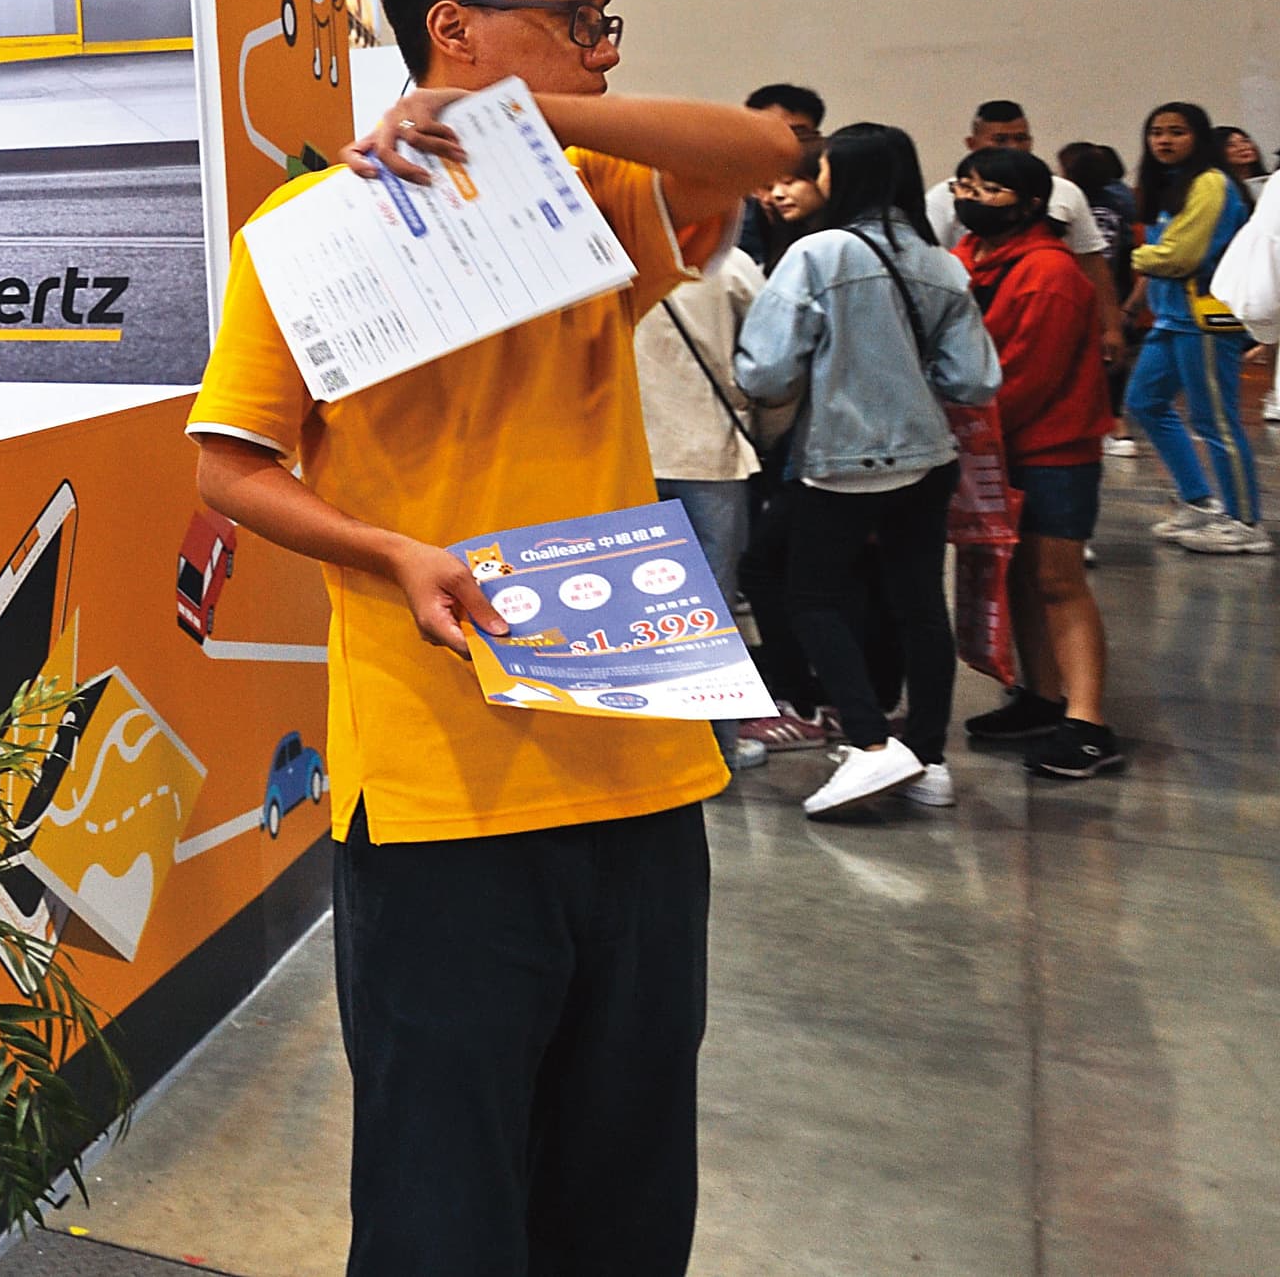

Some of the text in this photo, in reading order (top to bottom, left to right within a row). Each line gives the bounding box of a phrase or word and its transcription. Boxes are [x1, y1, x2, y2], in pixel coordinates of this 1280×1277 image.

[520, 525, 668, 563] Chailease 中租租車
[570, 608, 718, 657] $1,399
